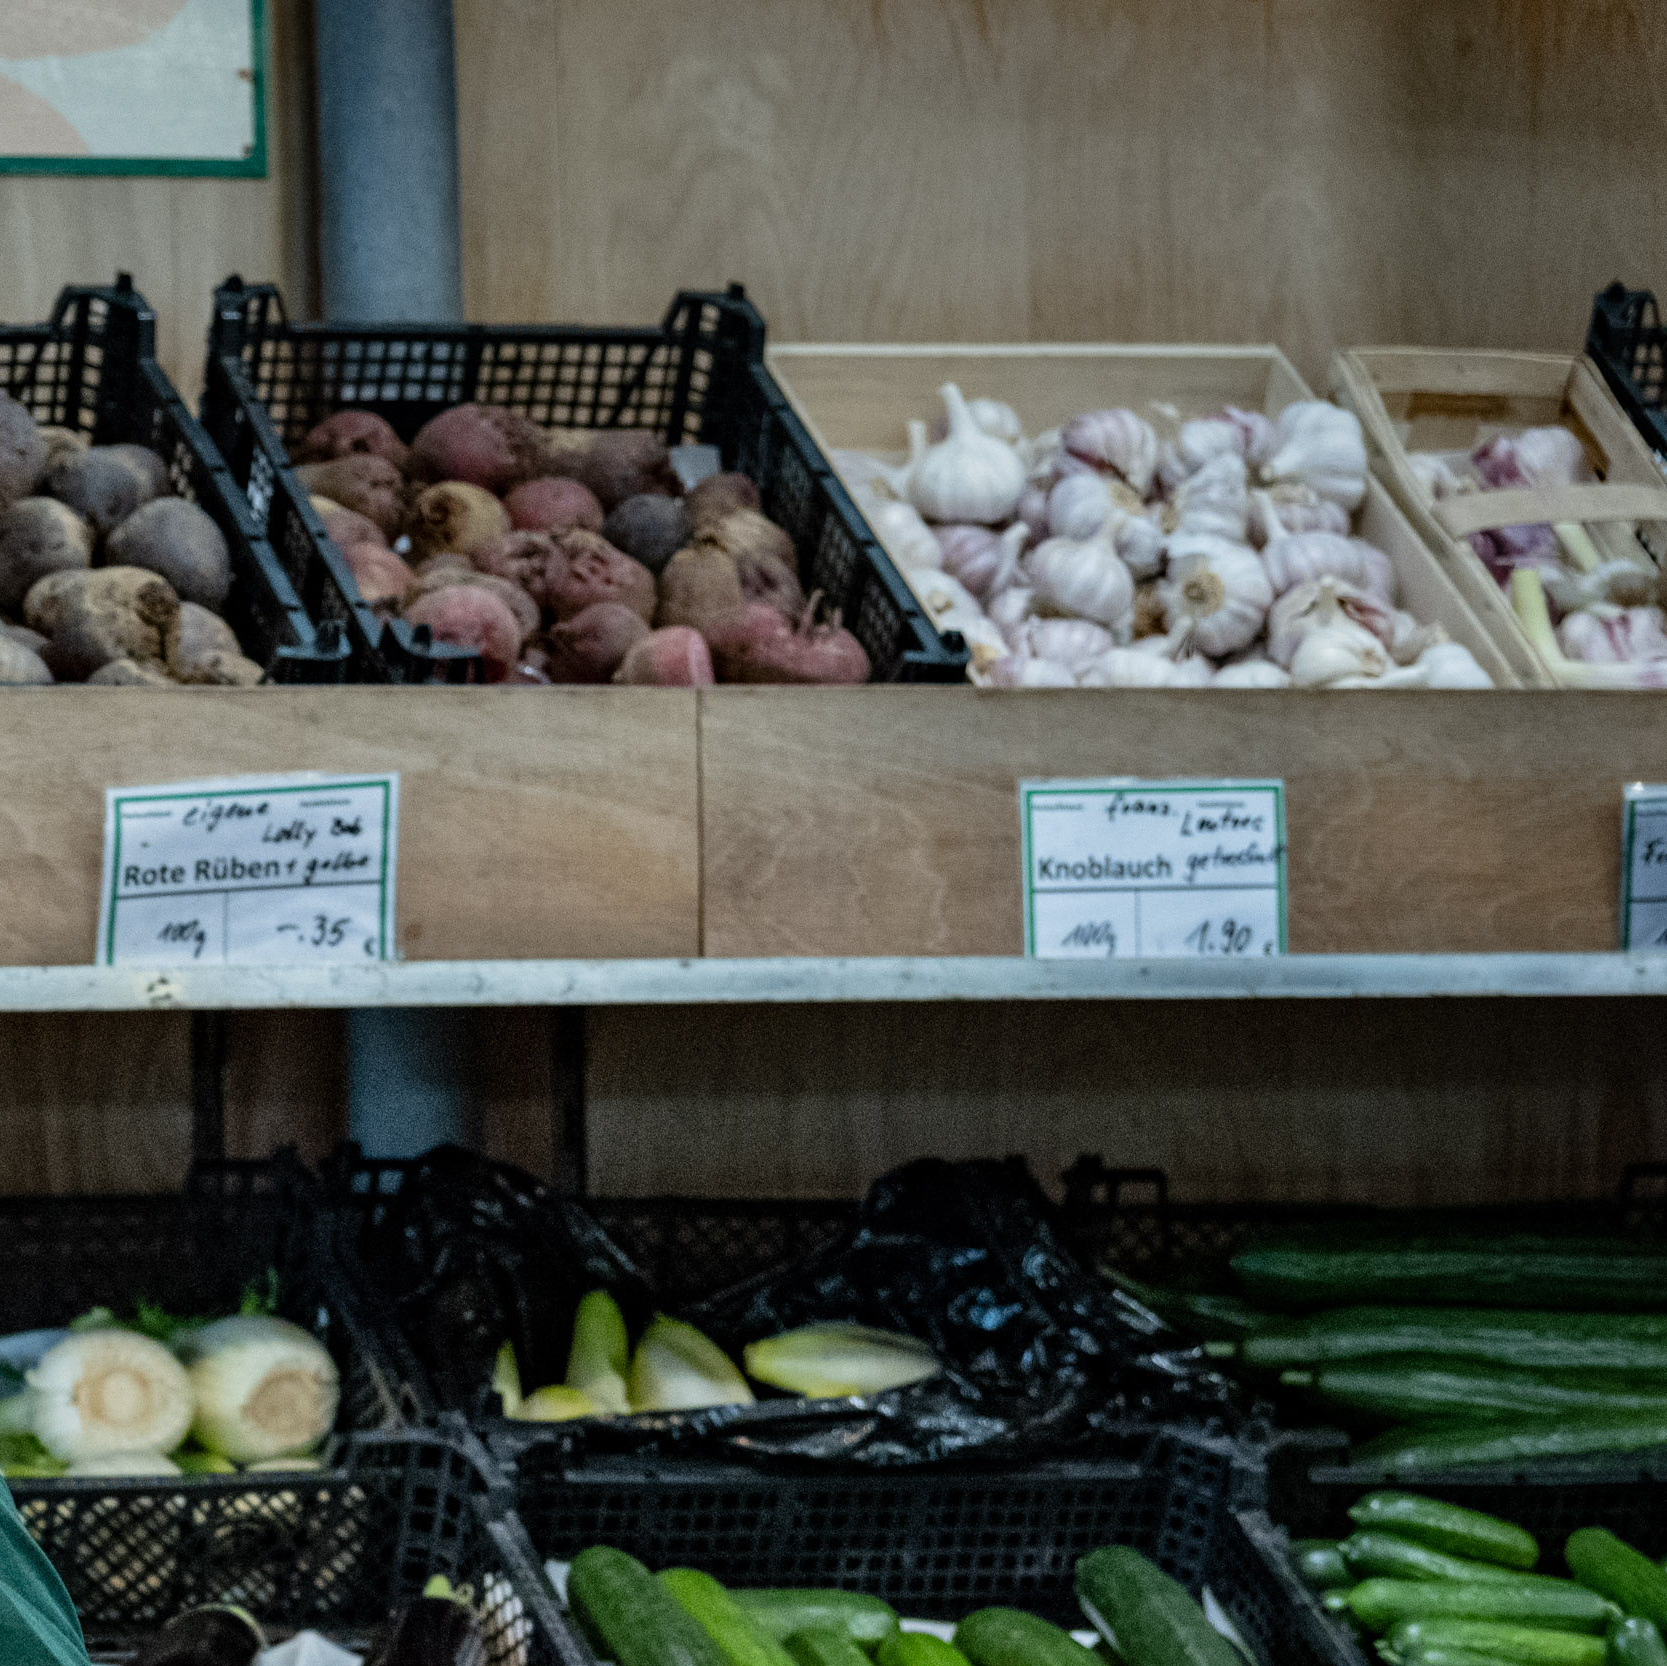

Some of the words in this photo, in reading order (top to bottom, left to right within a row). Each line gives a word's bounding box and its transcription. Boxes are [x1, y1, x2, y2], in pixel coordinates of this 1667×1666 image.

[123, 865, 186, 888] Rote
[194, 856, 281, 882] Rüben
[1038, 854, 1173, 881] Knoblauch
